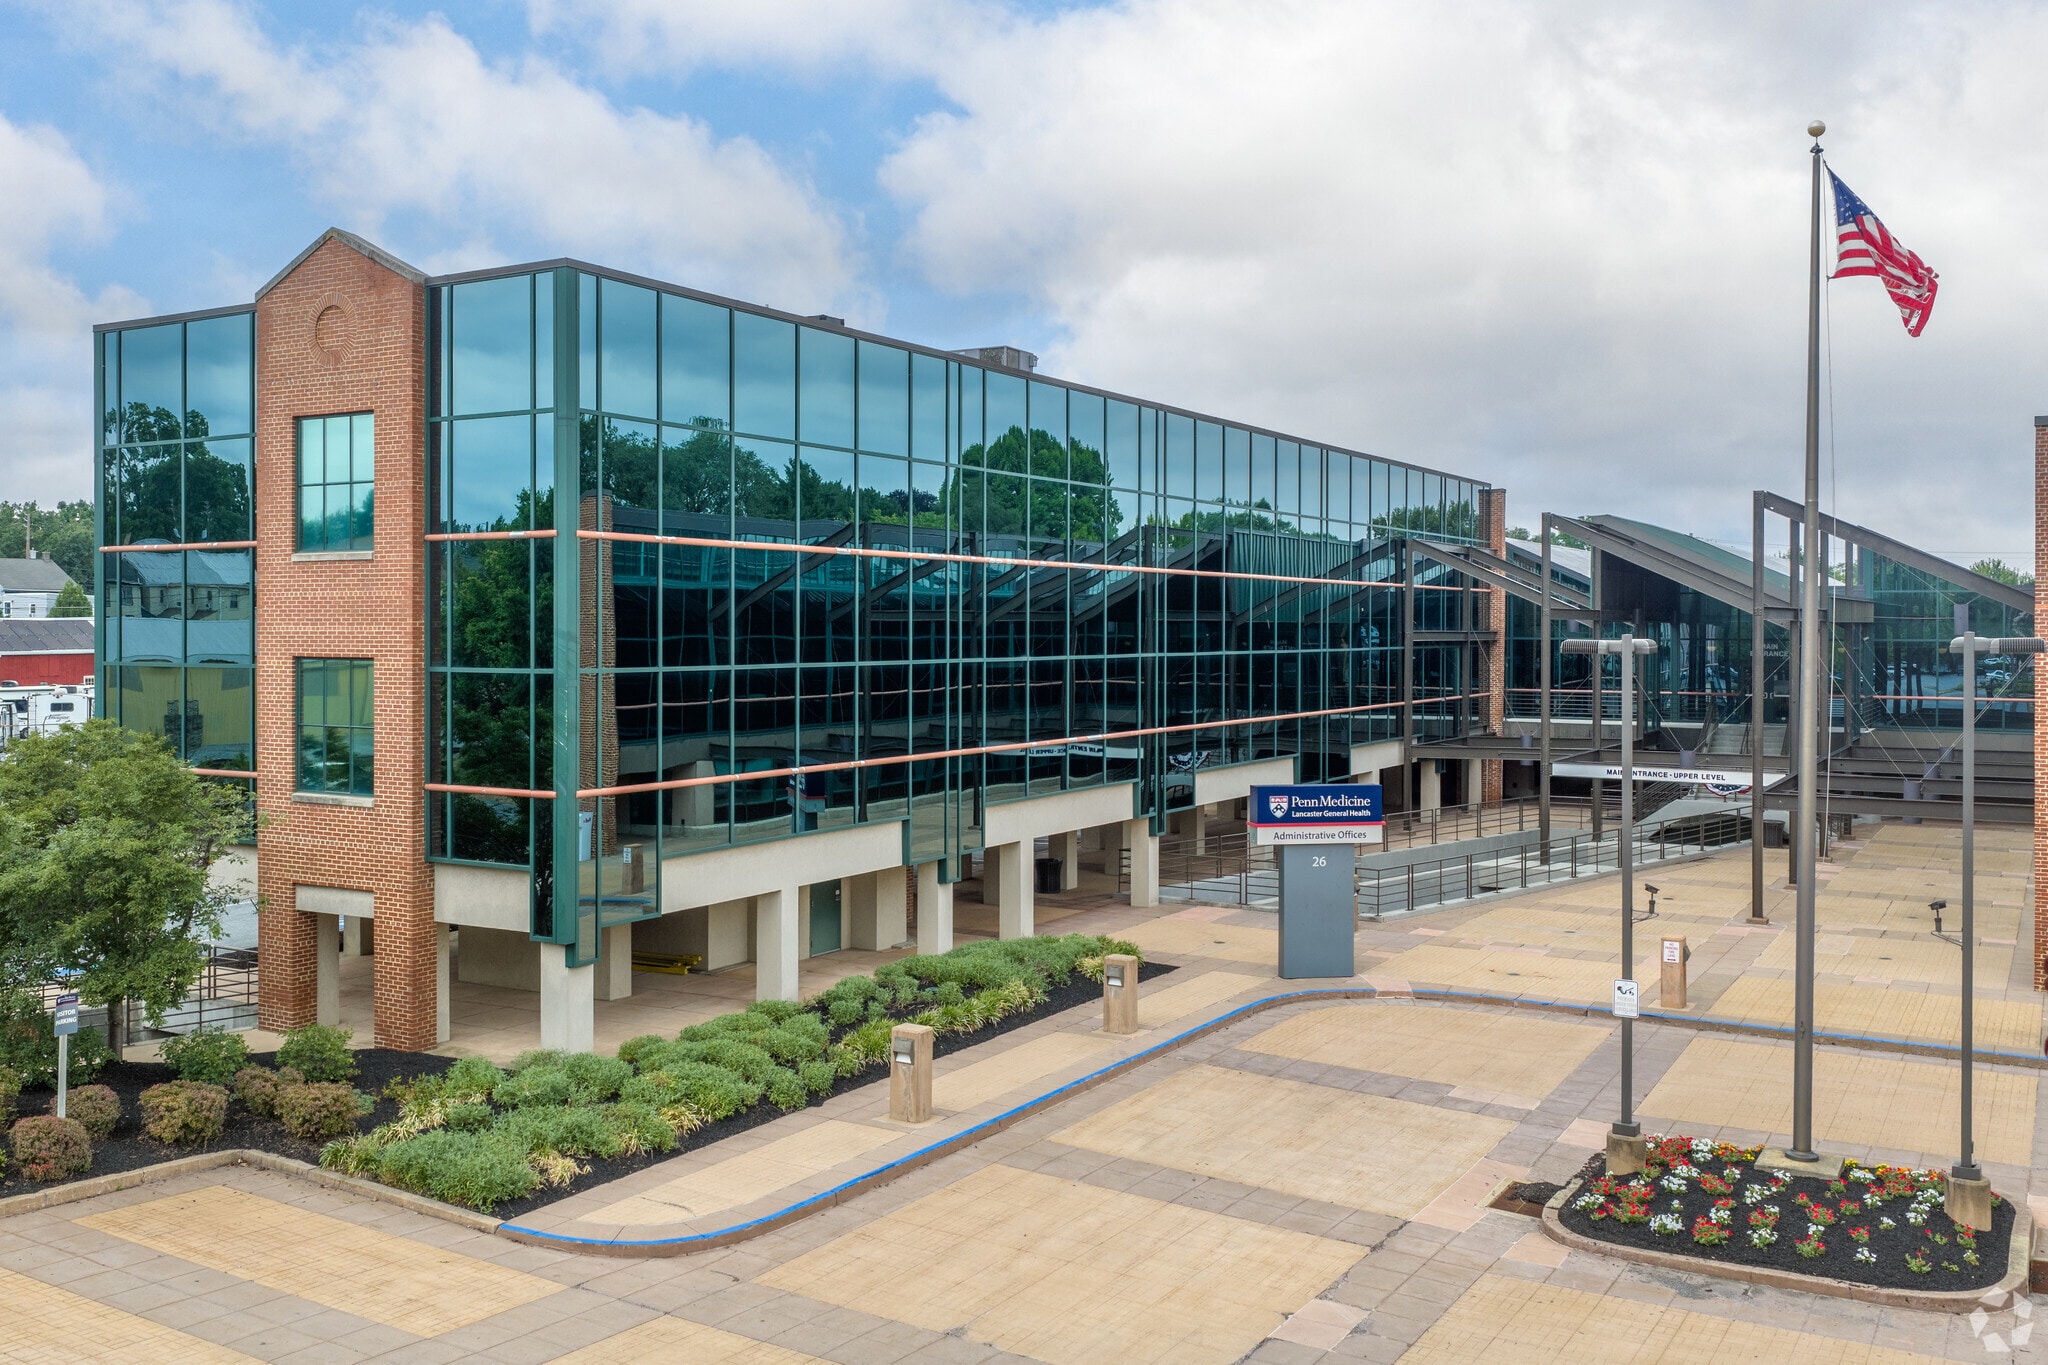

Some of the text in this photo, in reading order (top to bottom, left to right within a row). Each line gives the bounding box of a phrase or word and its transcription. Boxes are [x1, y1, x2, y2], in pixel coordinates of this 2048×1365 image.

[1632, 770, 1668, 778] NTRANCE
[1291, 794, 1371, 807] Penn Medicine
[1349, 809, 1371, 817] Health
[1273, 830, 1367, 840] Administrative Offices
[1312, 856, 1327, 867] 26
[56, 1009, 76, 1018] VISITOR
[55, 1017, 77, 1026] PARKING
